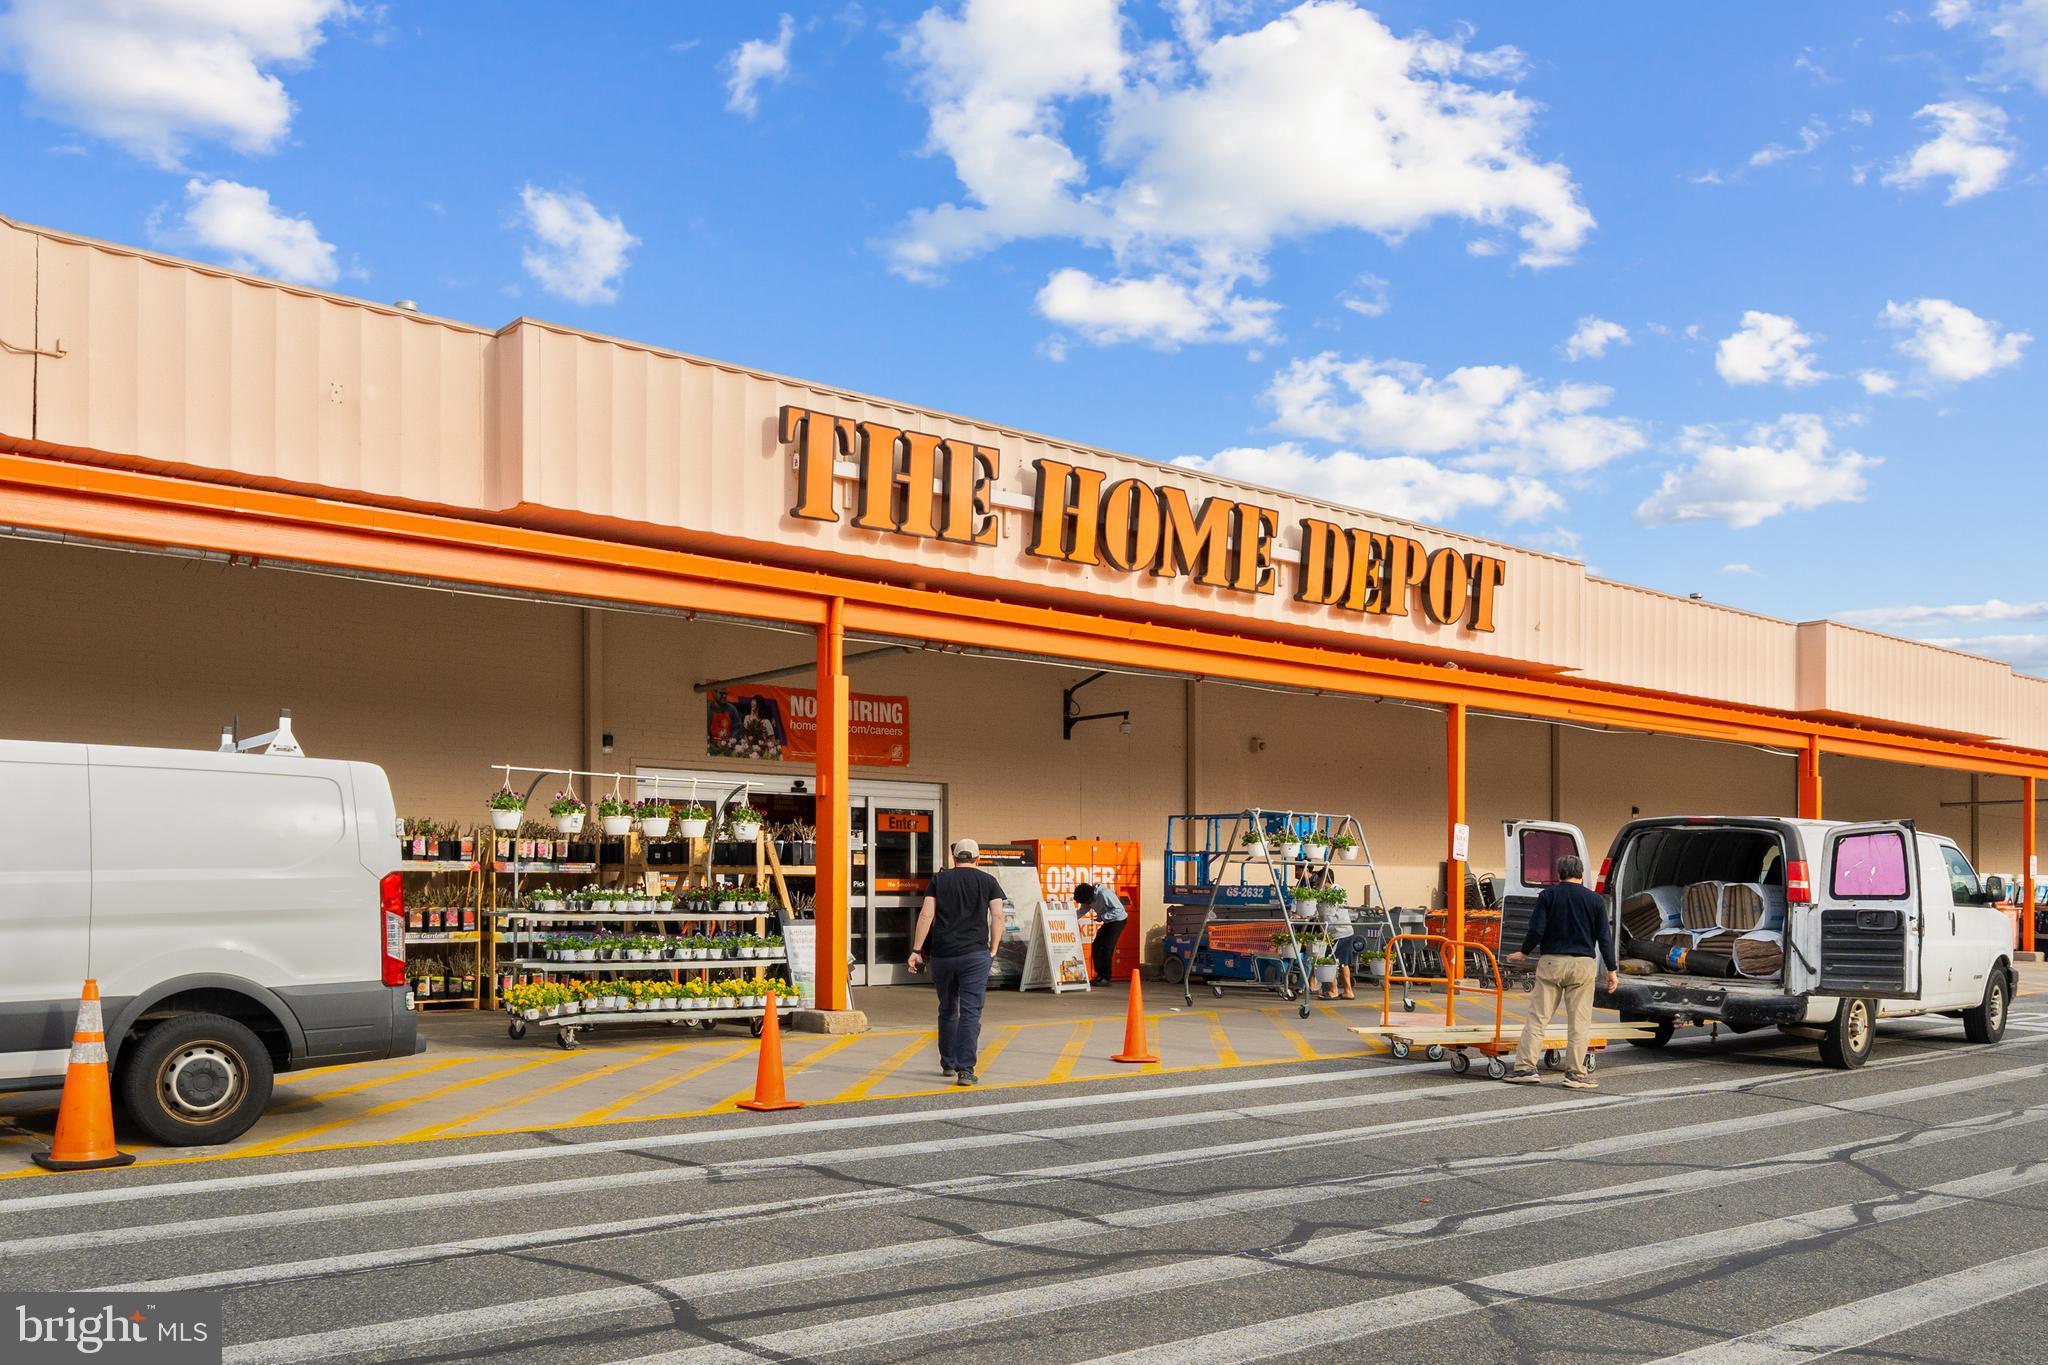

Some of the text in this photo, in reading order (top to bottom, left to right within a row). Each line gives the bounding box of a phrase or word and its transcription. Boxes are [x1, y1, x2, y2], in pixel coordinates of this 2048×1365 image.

[779, 405, 1506, 633] THE HOME DEPOT
[790, 695, 817, 719] NO
[889, 816, 919, 830] Enter
[1046, 865, 1115, 893] ORDER
[1226, 887, 1264, 897] GS-2632
[1048, 920, 1066, 931] NOW
[1050, 932, 1077, 944] HIRING
